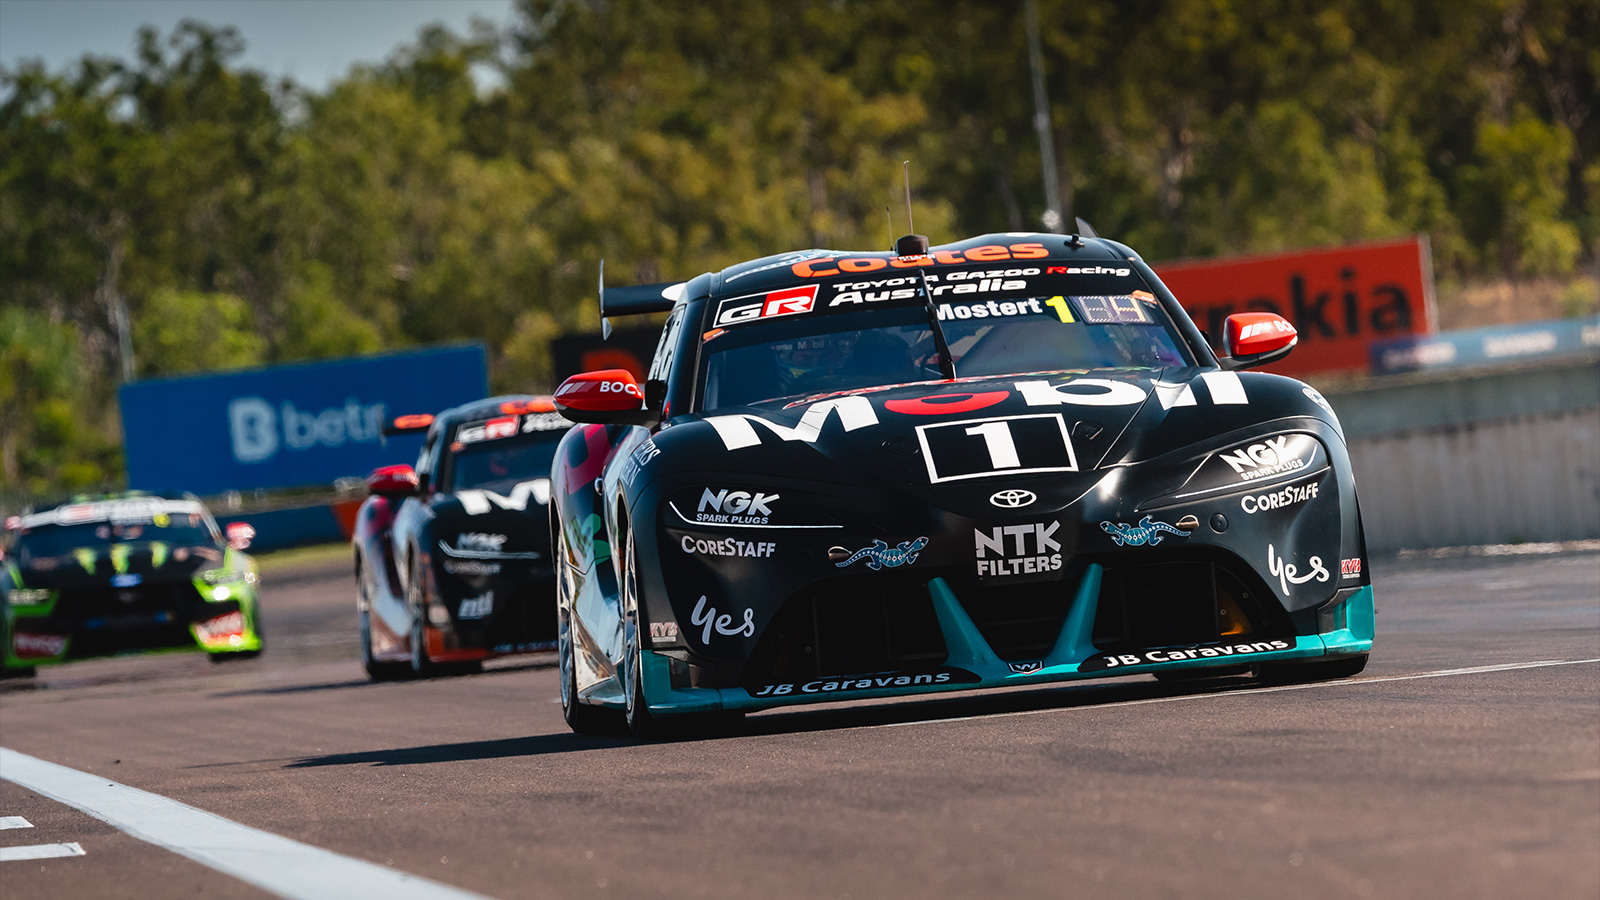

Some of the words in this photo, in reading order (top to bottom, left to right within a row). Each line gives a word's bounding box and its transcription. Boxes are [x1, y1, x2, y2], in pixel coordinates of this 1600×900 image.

[791, 243, 1050, 278] Coates
[829, 278, 1027, 307] Australia
[833, 273, 940, 292] TOYOTA
[946, 266, 1041, 281] GAZOO
[1046, 265, 1131, 278] Racing
[719, 295, 811, 324] GR
[937, 298, 1044, 321] Mostert
[1045, 295, 1075, 323] 1
[702, 371, 1249, 452] Mobil
[965, 421, 1020, 469] 1
[1219, 435, 1292, 473] NGK
[1240, 466, 1275, 480] SPARK
[1275, 458, 1304, 474] PLUGS
[697, 487, 780, 516] NGK
[696, 512, 729, 523] SPARK
[731, 515, 769, 524] PLUGS
[975, 520, 1061, 558] NTK
[977, 554, 1062, 576] FILTERS
[1341, 558, 1361, 574] KYB
[649, 622, 678, 637] KYB
[1103, 653, 1141, 667] JB
[1146, 639, 1289, 662] Caravans
[757, 684, 794, 695] JB
[801, 671, 950, 692] Caravans
